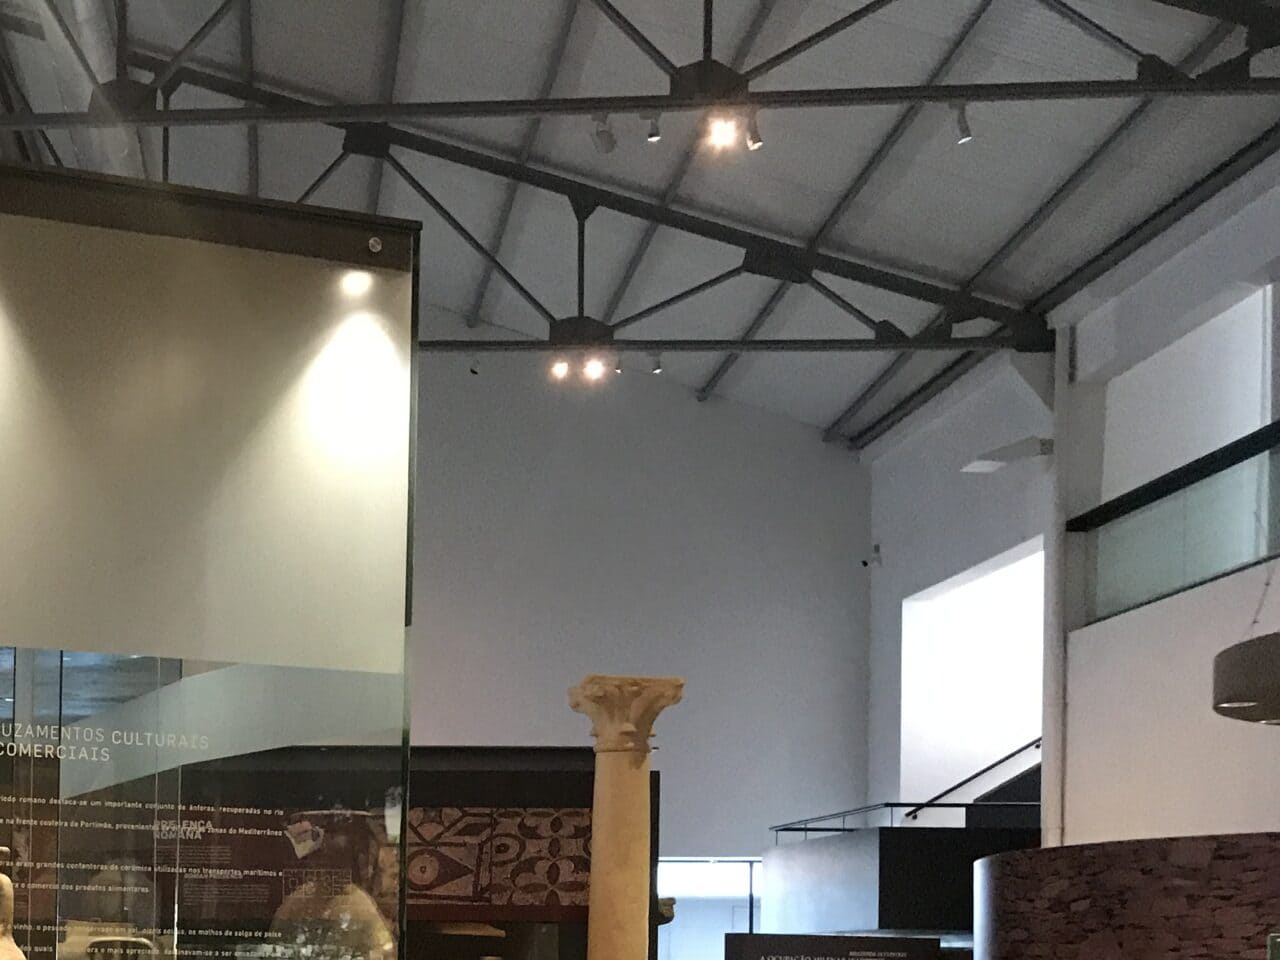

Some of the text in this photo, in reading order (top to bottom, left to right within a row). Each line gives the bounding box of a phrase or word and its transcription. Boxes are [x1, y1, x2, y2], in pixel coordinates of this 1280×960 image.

[111, 730, 209, 750] CULTURAIS
[19, 796, 47, 804] romano
[104, 800, 142, 809] importante
